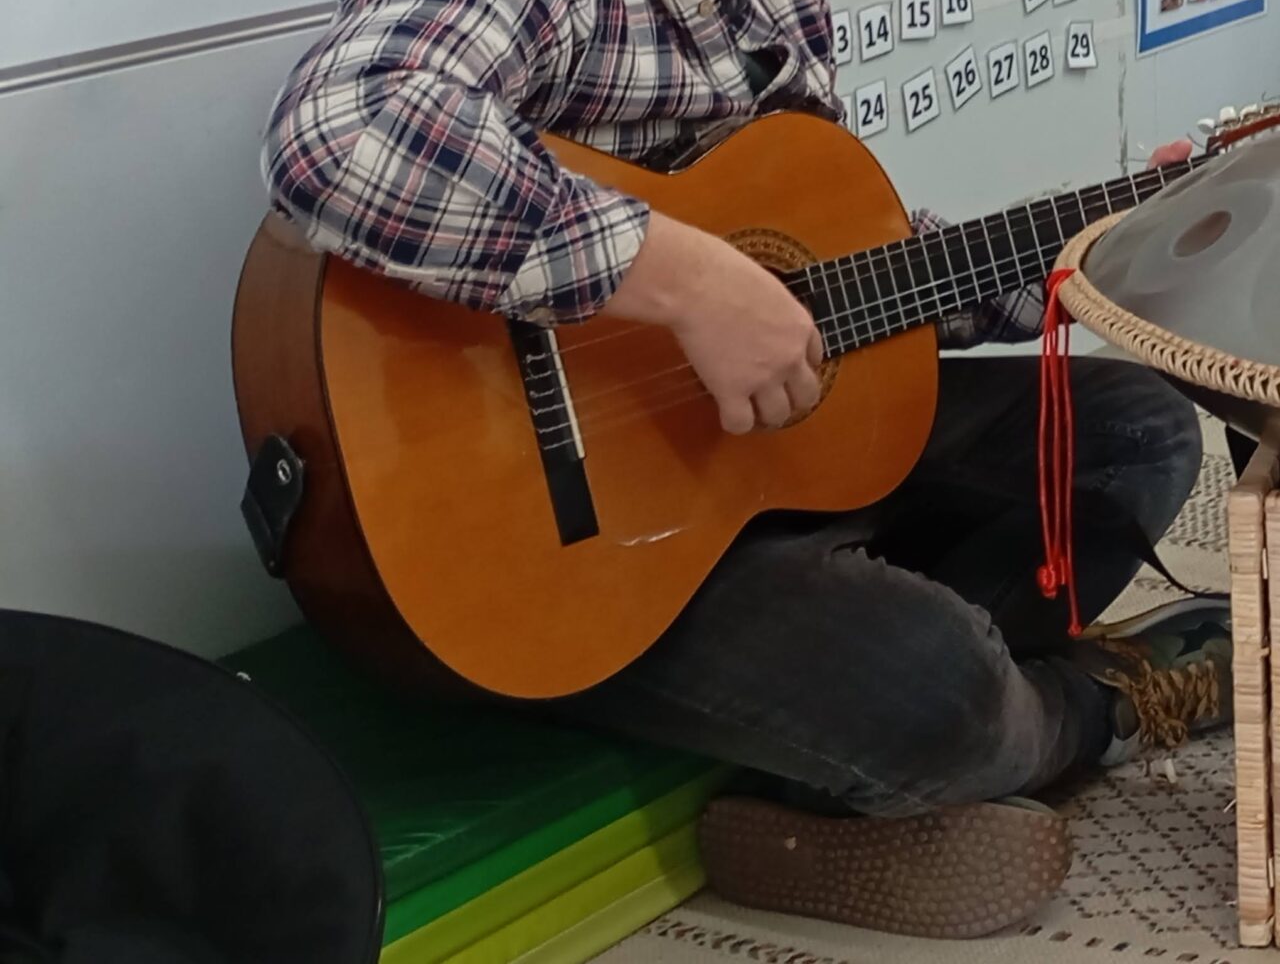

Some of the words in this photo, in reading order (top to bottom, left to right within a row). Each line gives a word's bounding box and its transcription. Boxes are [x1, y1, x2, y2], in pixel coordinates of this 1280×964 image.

[836, 24, 849, 54] 3
[863, 15, 889, 50] 14
[906, 0, 931, 29] 15
[860, 93, 885, 127] 24
[909, 83, 934, 121] 25
[952, 59, 977, 98] 26
[992, 52, 1014, 86] 27
[1028, 44, 1050, 78] 28
[1070, 32, 1091, 59] 29
